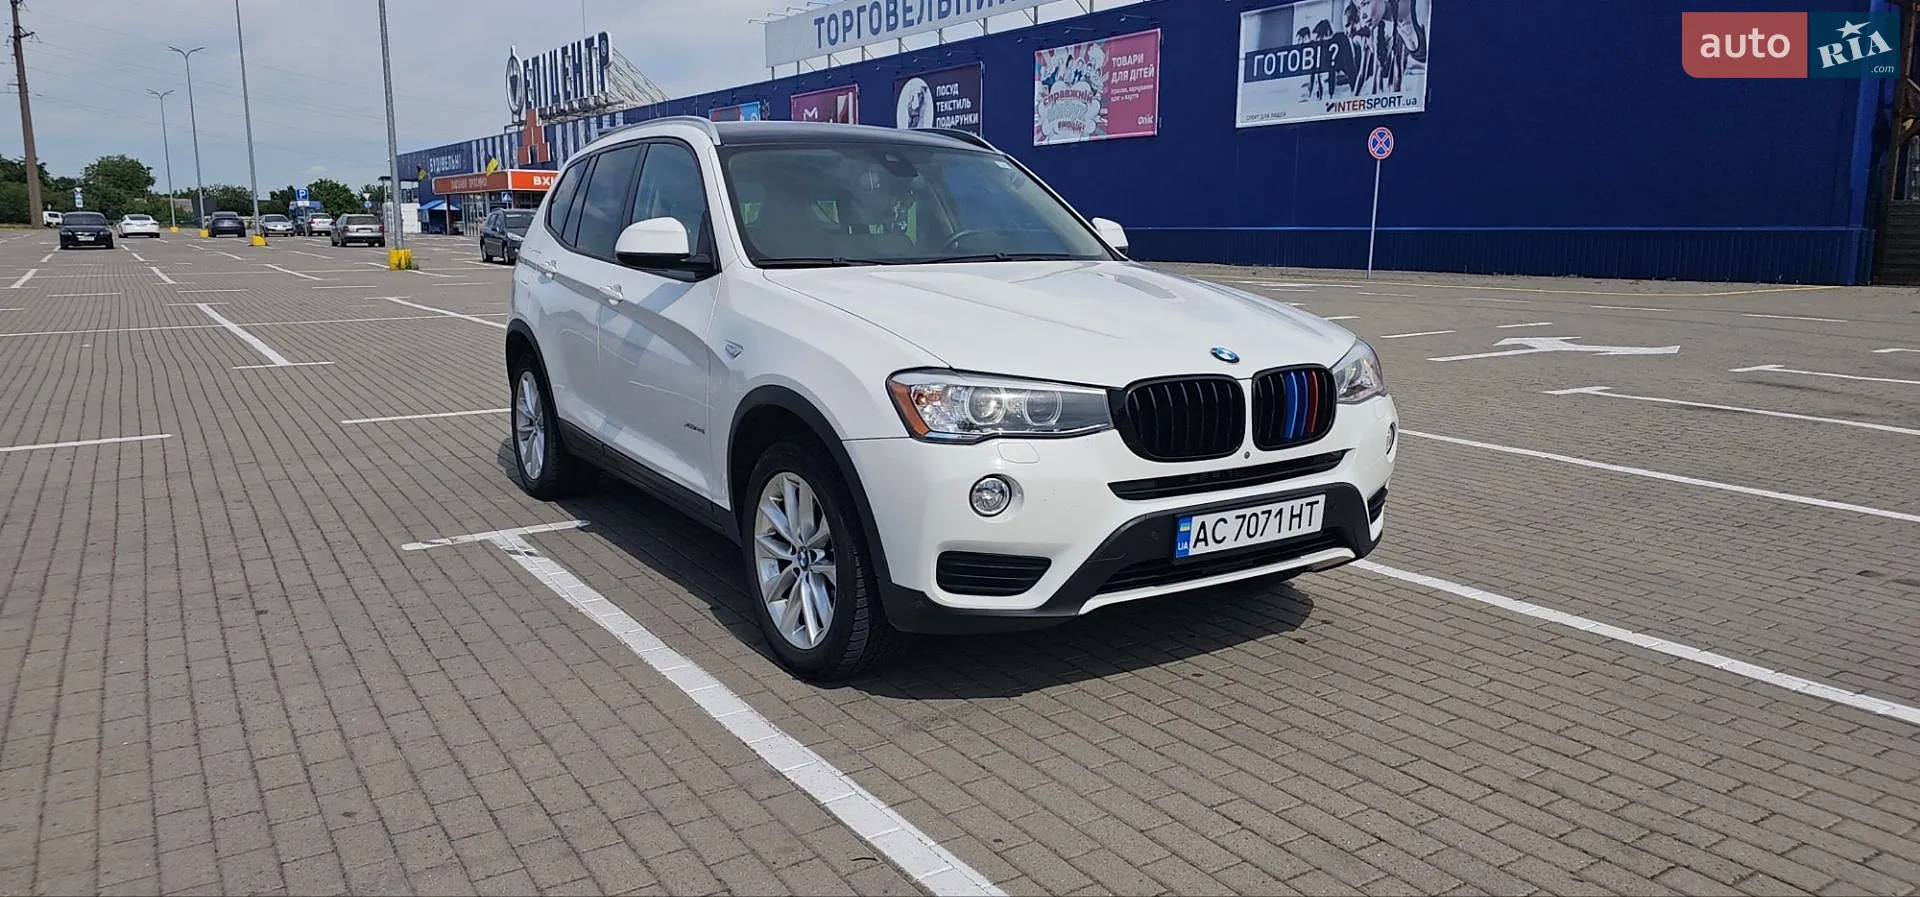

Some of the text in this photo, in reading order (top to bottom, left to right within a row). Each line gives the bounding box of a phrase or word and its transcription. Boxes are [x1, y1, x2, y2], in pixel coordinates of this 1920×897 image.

[813, 0, 1016, 49] ТОРГОВЕЛЬ
[1111, 53, 1144, 68] ТОВАРИ
[1253, 43, 1339, 76] ГОТОВІ ?
[1111, 63, 1155, 84] ДЛЯ ДІТЕЙ
[936, 83, 959, 97] ПОСУД
[936, 98, 972, 112] ТЕКСТИЛЬ
[1334, 95, 1417, 112] INTERSPORT.ua
[936, 112, 979, 128] ПОДАРУНКИ
[533, 176, 554, 186] ВХІ
[1193, 500, 1320, 549] AC 7071 HT
[1177, 541, 1189, 550] UA
